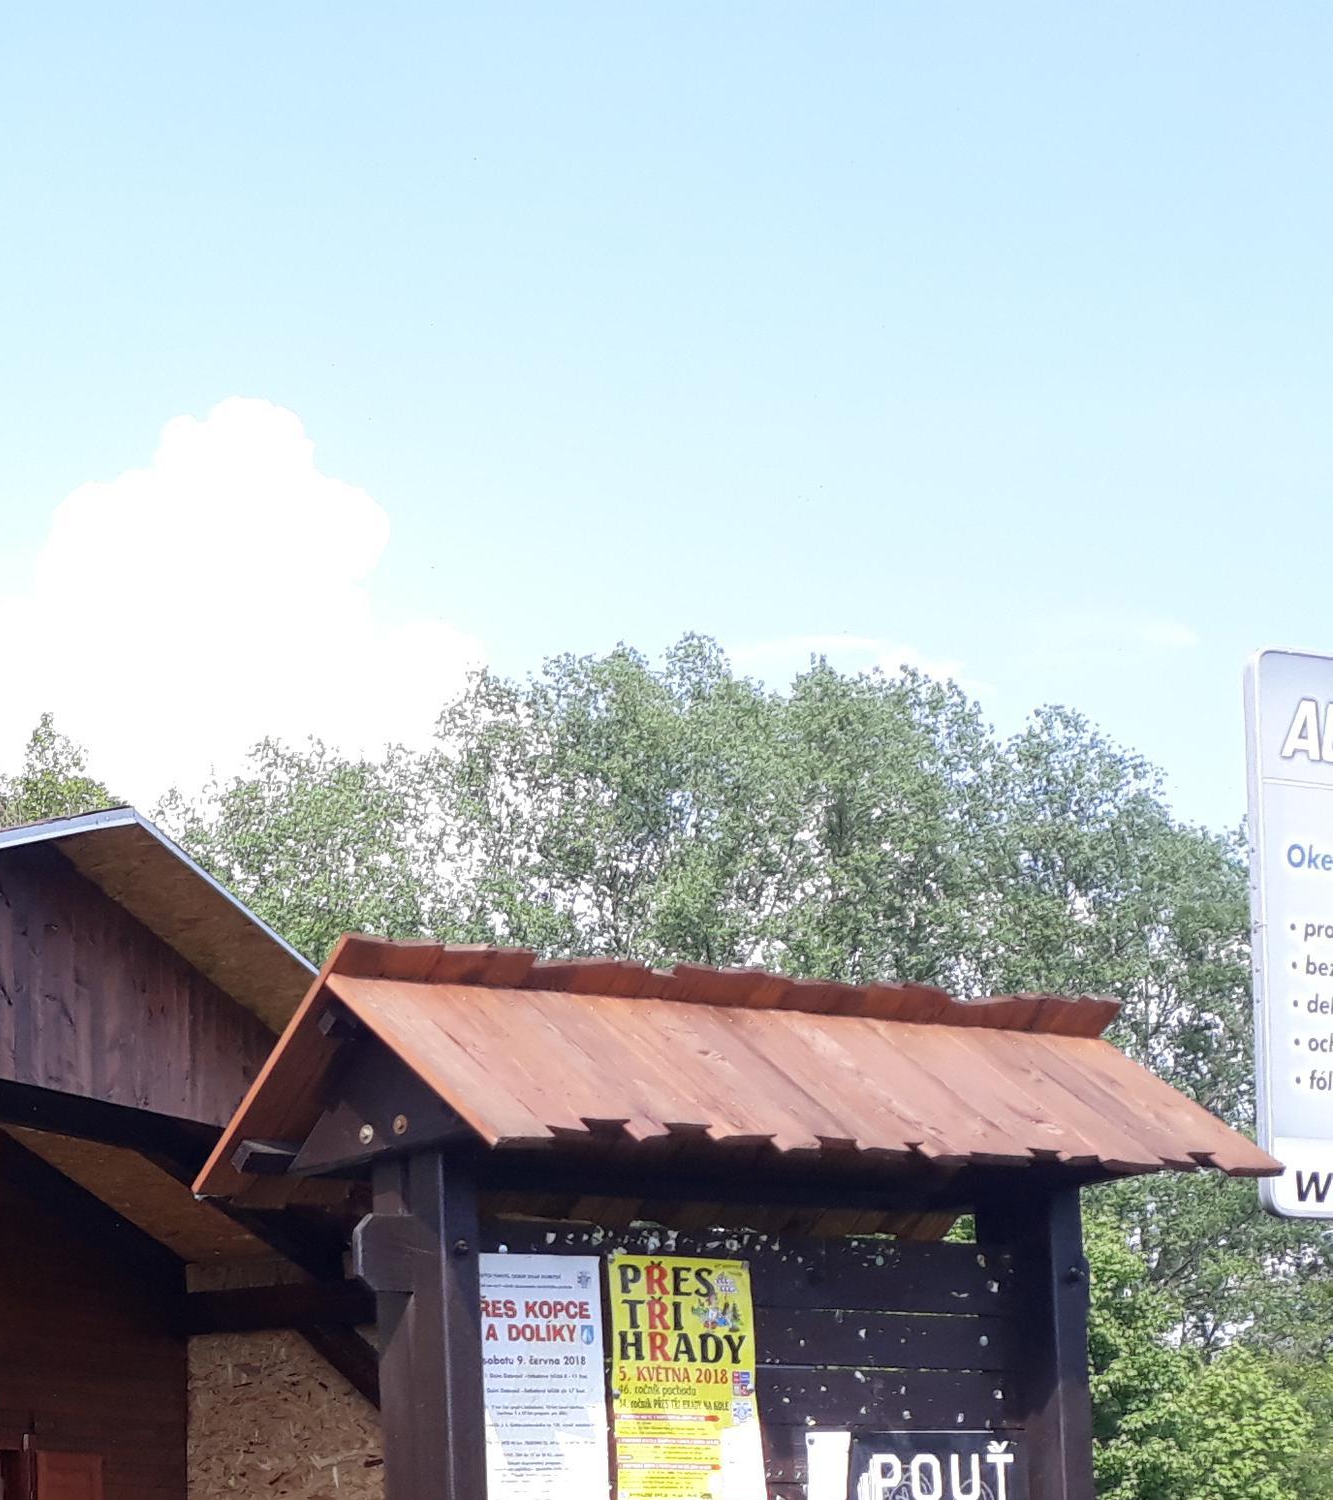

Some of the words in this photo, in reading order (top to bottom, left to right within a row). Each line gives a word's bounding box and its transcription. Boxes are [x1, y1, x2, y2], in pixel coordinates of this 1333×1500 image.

[1307, 993, 1333, 1015] de
[617, 1260, 717, 1297] PŘES
[524, 1300, 591, 1320] KOPCE
[621, 1296, 685, 1331] TŘI
[485, 1323, 498, 1341] A
[507, 1320, 577, 1342] DOLÍKY
[618, 1330, 747, 1364] HRADY
[563, 1356, 586, 1366] 2018
[618, 1365, 631, 1382] 5.
[636, 1365, 691, 1383] KVĚTNA
[696, 1368, 729, 1385] 2018
